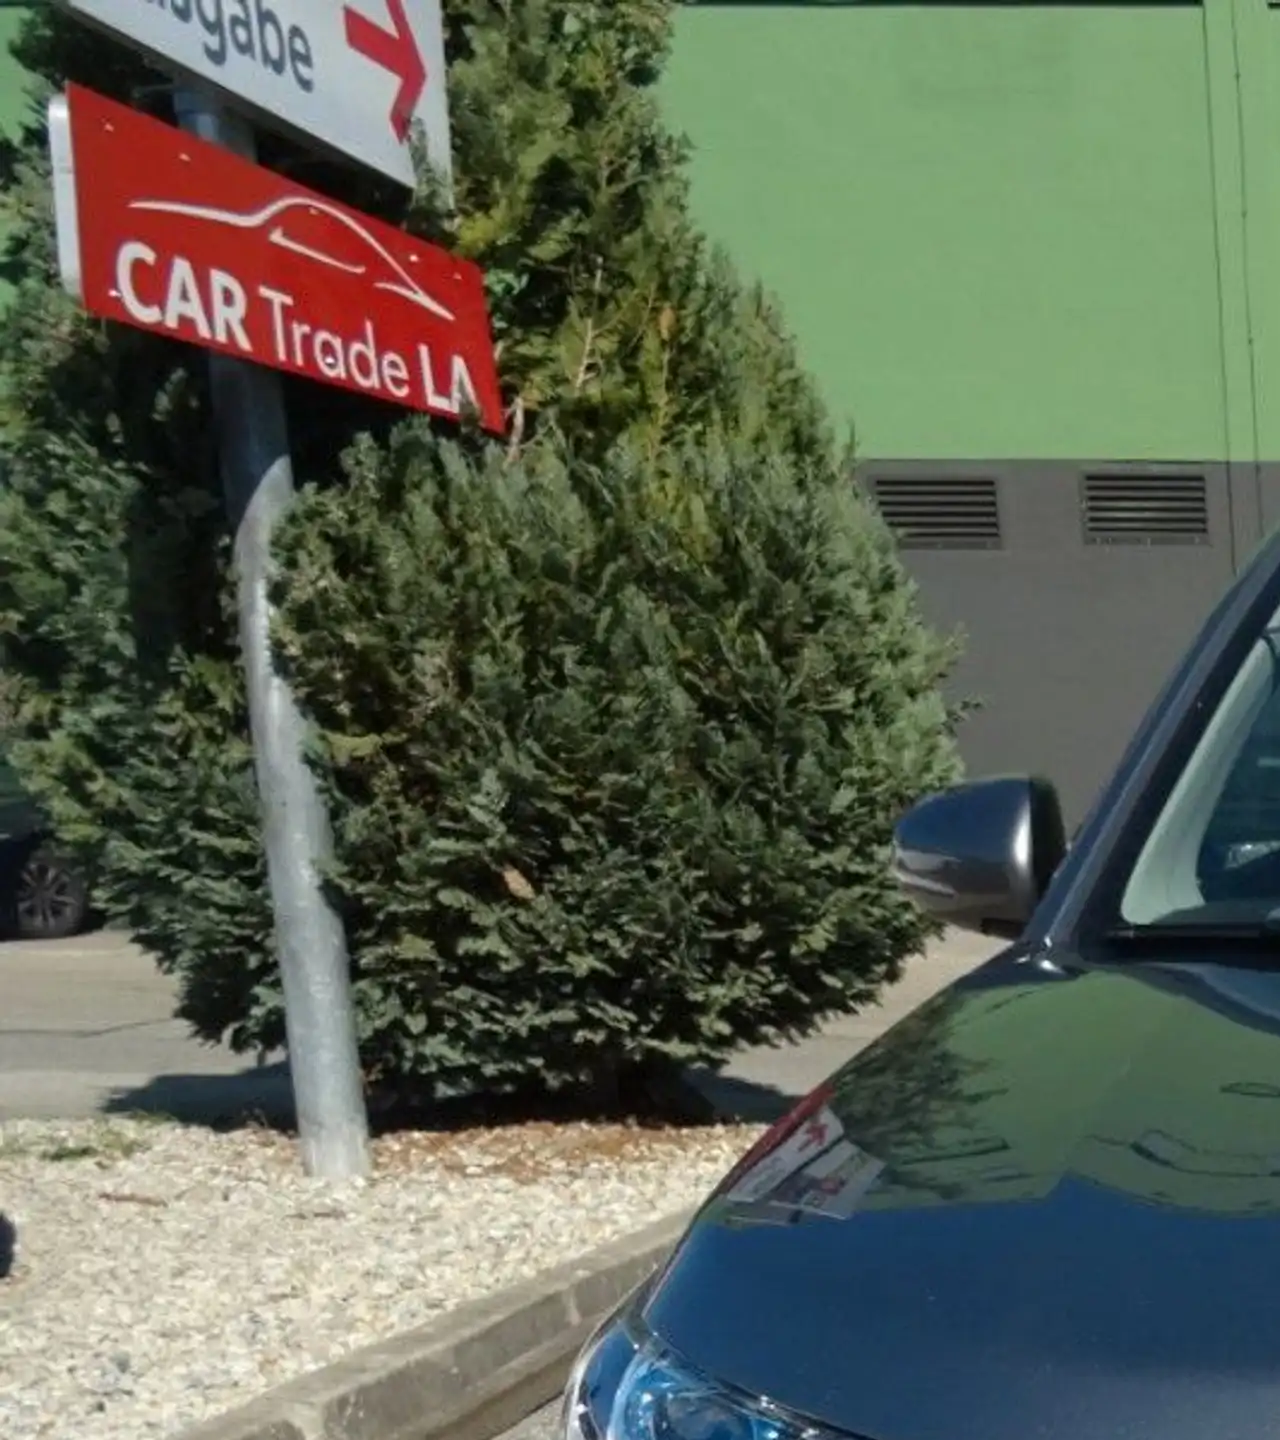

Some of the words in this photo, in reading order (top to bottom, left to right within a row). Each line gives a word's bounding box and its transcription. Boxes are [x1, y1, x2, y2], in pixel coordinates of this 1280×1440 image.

[147, 0, 315, 93] gabe
[116, 241, 252, 353] CAR
[258, 285, 410, 397] Trade
[418, 343, 480, 416] LA
